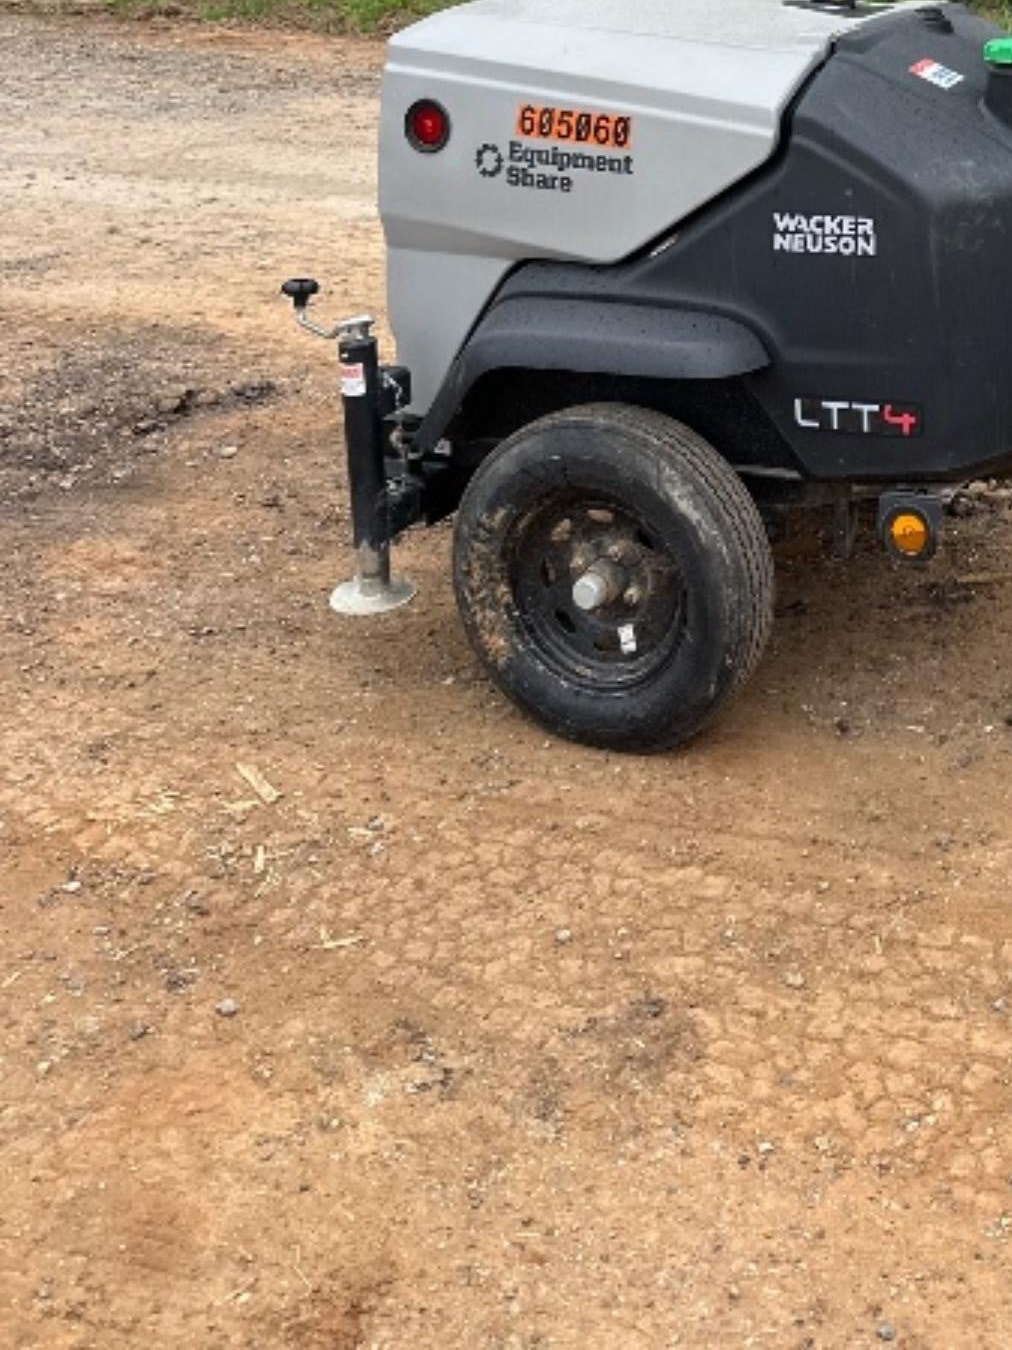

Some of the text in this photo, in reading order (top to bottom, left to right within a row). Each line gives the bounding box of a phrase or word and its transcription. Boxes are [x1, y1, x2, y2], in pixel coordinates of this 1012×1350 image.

[519, 105, 631, 147] 605060
[508, 140, 634, 174] Equipment
[506, 164, 573, 193] Share
[773, 212, 874, 235] WACKER
[773, 233, 877, 256] NEUSON
[794, 398, 917, 436] LTT4
